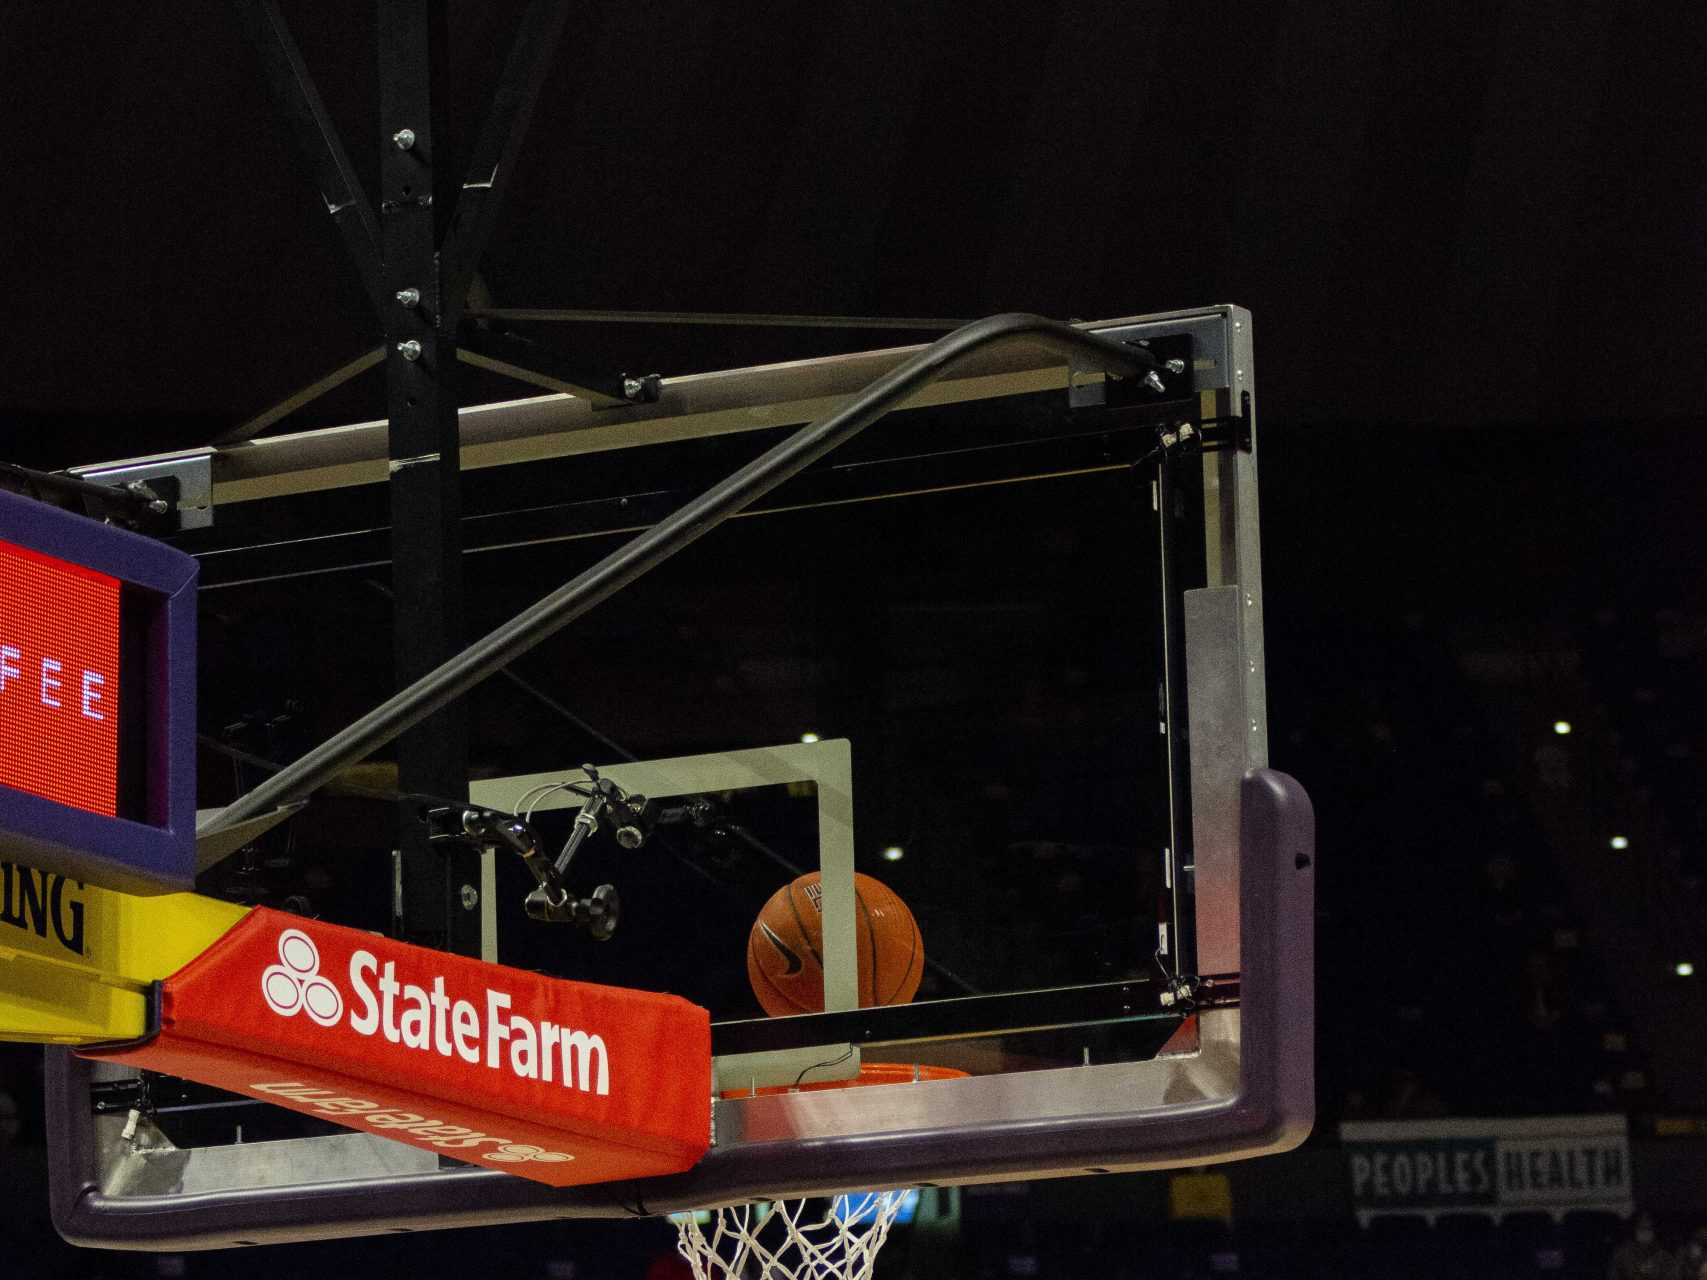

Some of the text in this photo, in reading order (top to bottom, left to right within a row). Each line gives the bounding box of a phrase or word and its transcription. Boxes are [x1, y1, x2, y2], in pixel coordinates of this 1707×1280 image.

[0, 645, 105, 721] FEE
[1352, 1148, 1627, 1198] PEOPLES HEALTH
